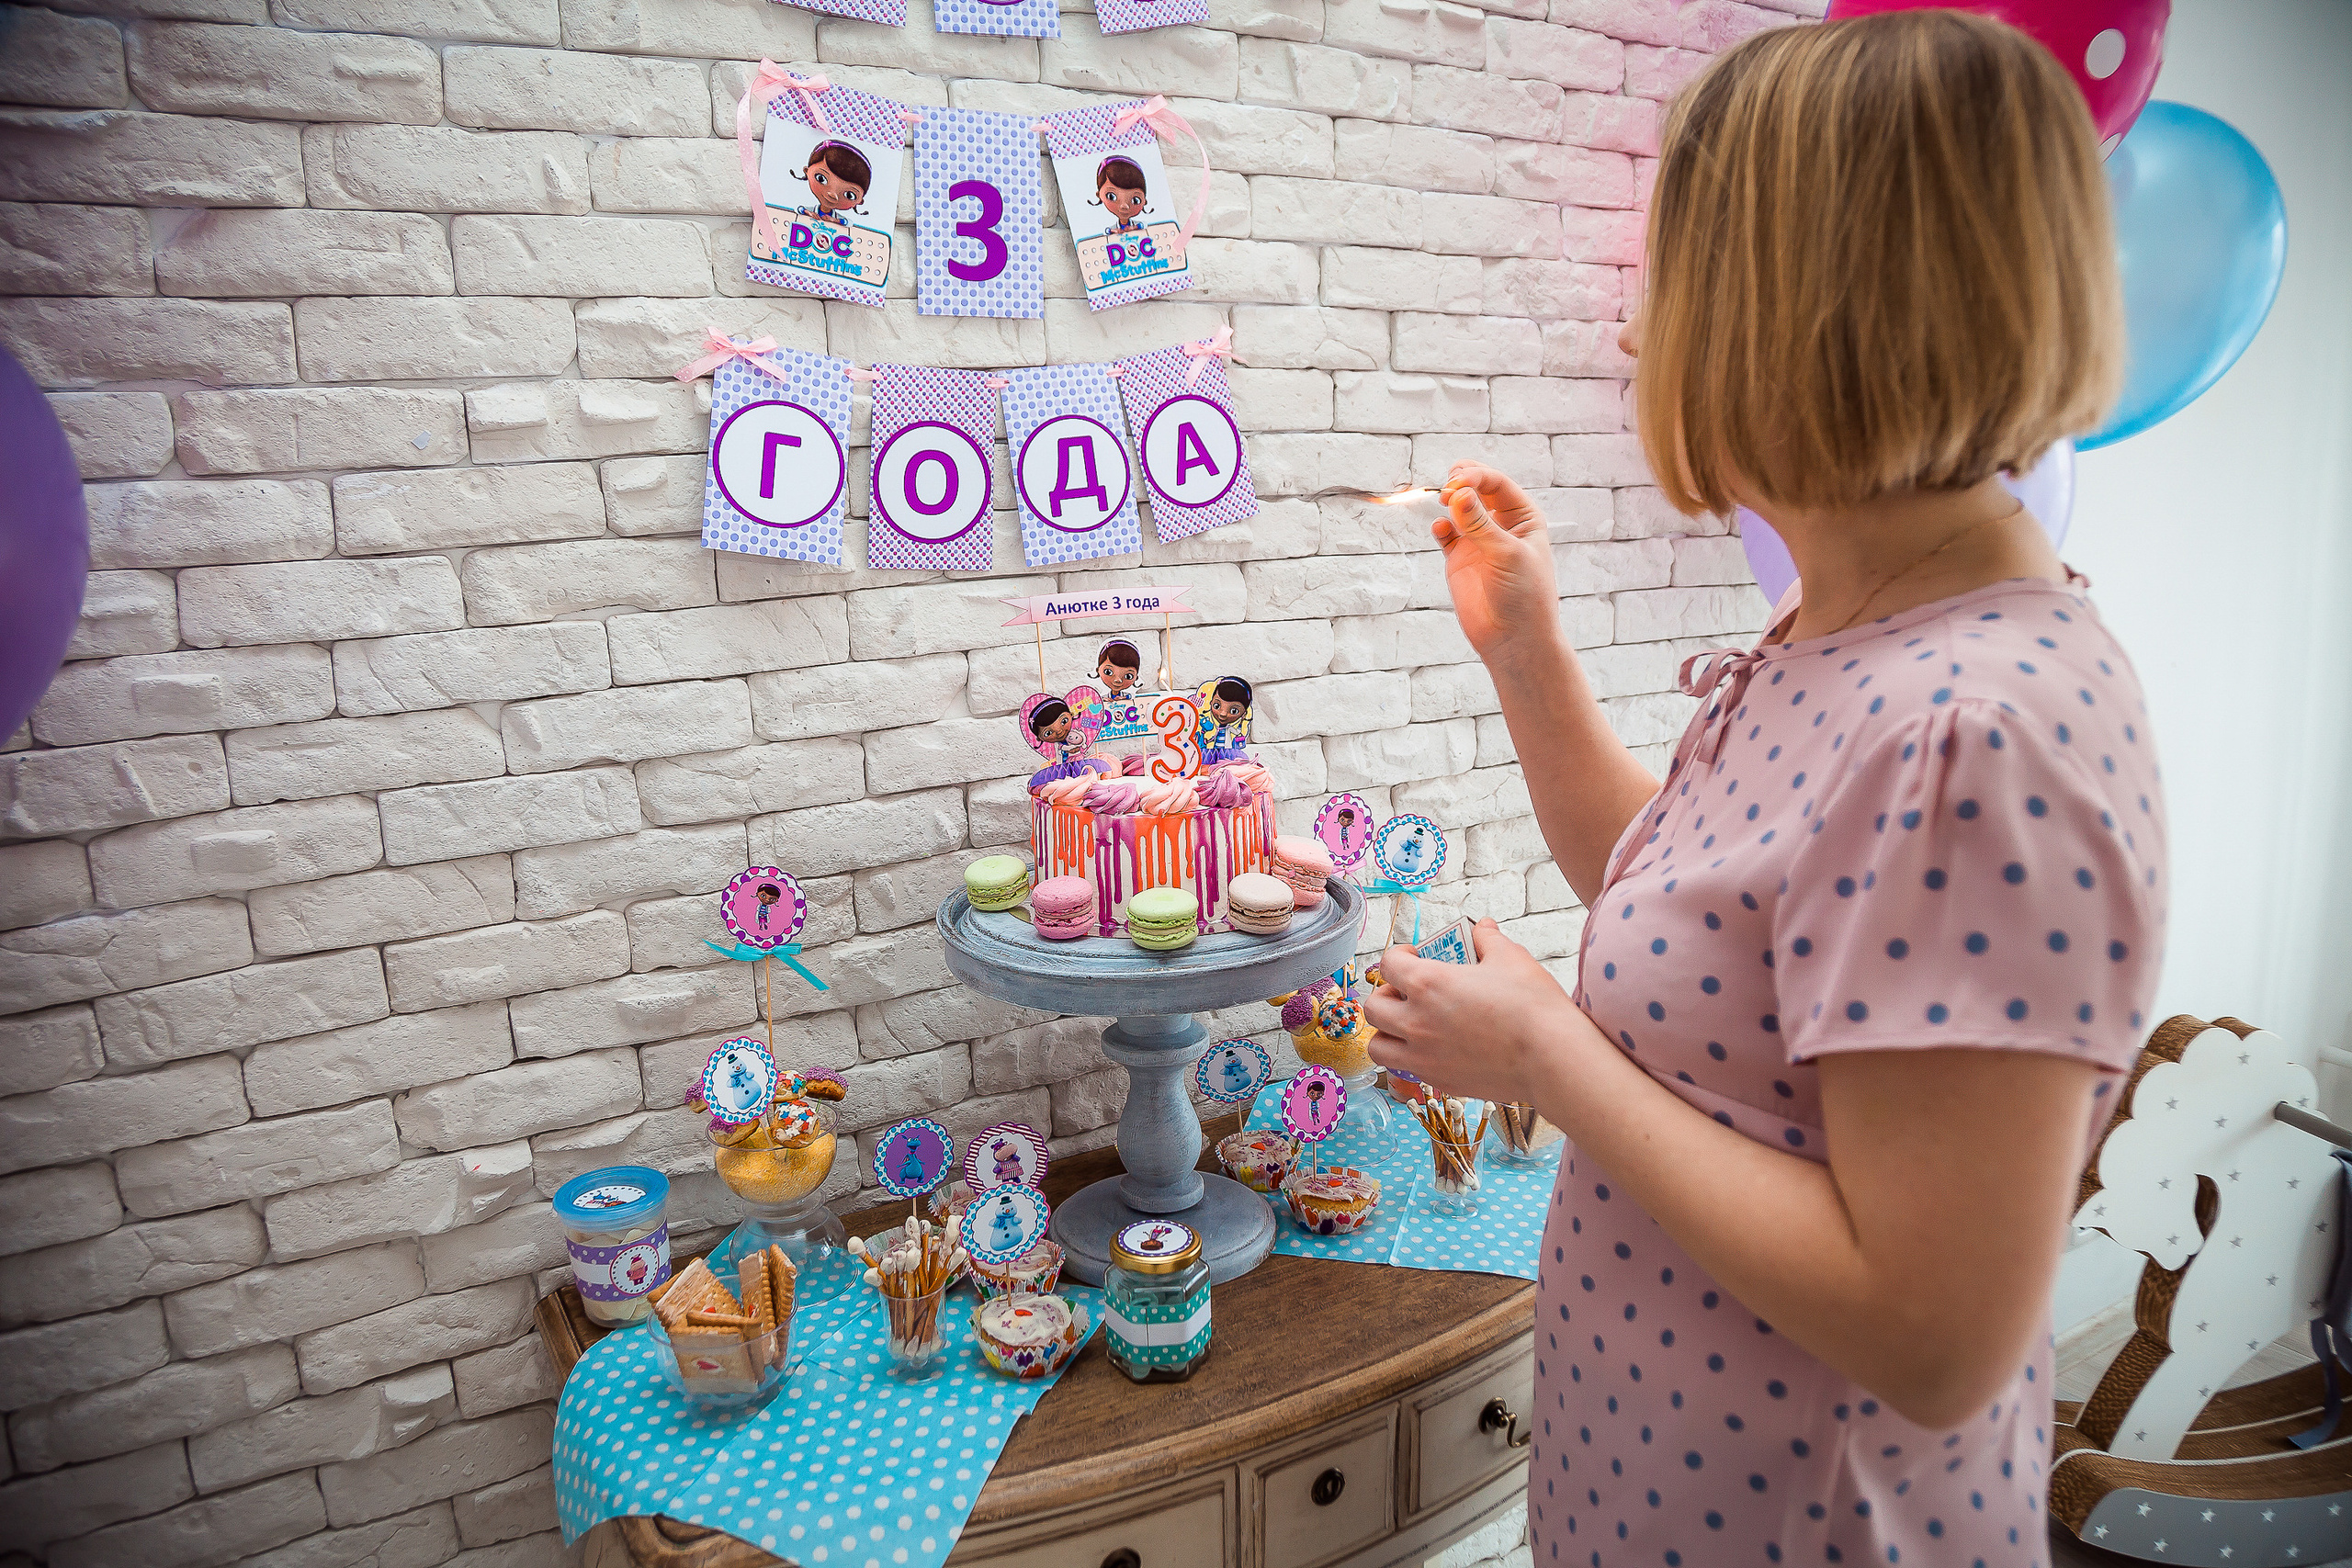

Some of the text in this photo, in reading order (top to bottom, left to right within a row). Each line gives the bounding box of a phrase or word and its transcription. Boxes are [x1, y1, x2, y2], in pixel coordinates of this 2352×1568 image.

[946, 178, 1009, 282] 3
[1100, 257, 1170, 285] McStuffins
[1045, 596, 1160, 616] Анютке 3 года
[1097, 723, 1149, 740] cStuffins
[1150, 696, 1203, 784] 3
